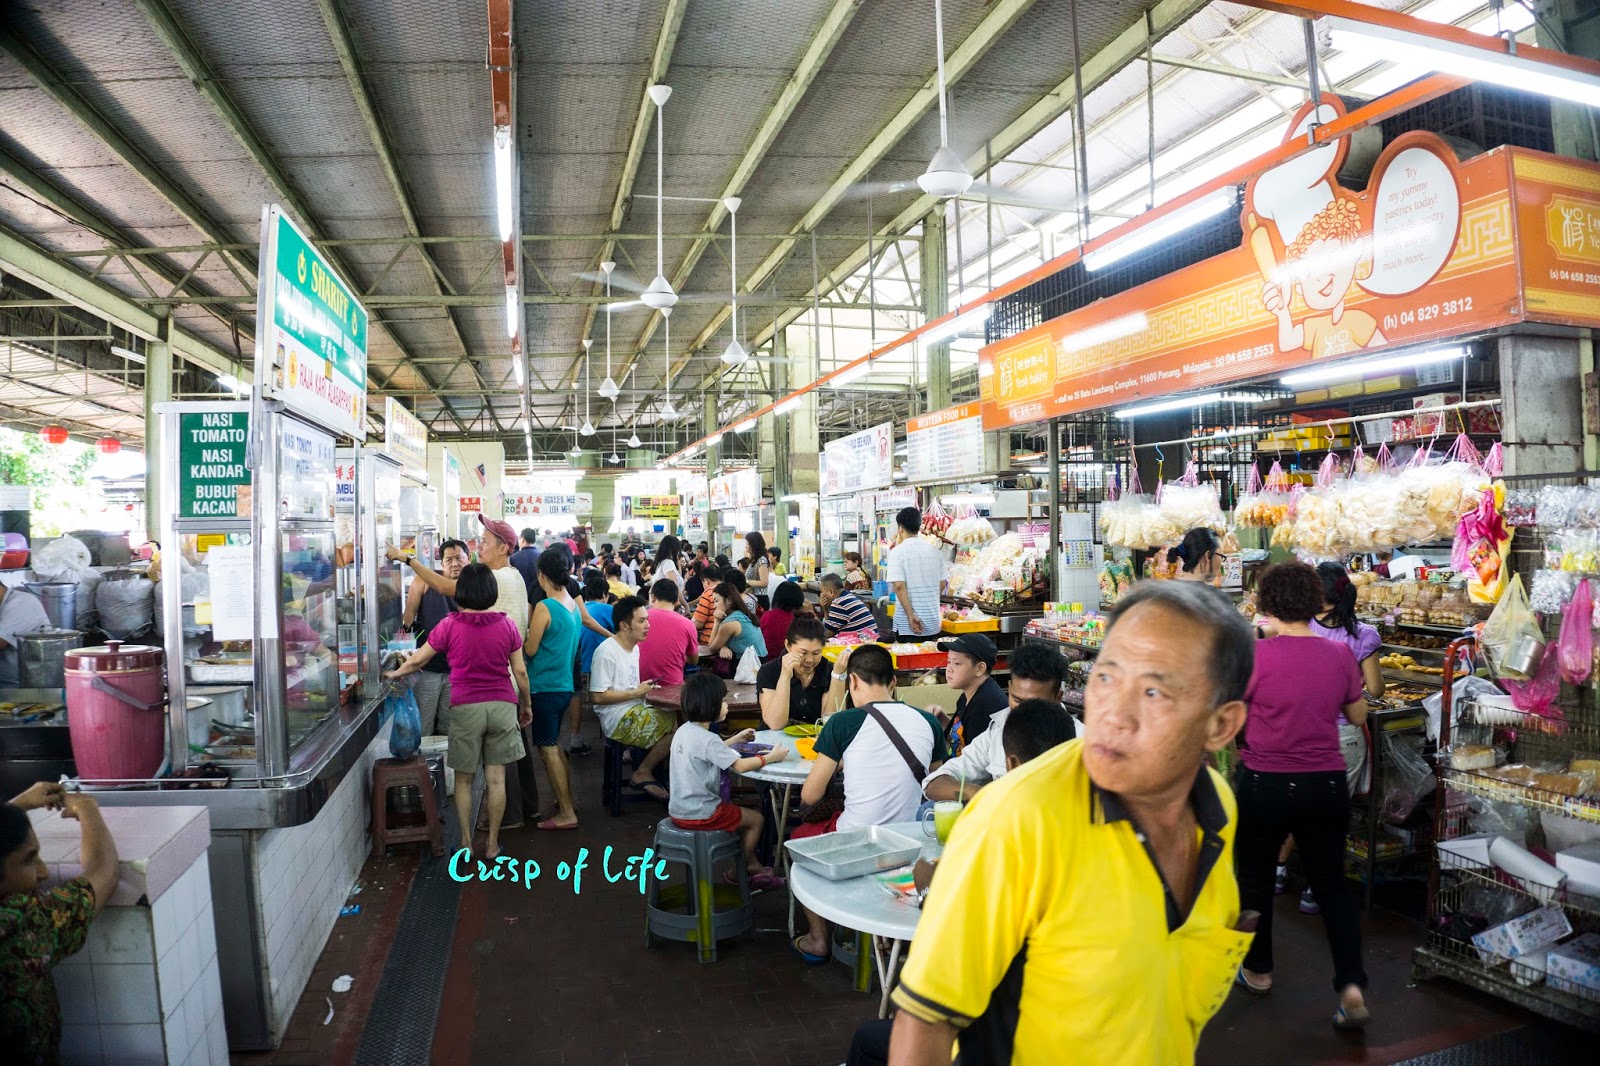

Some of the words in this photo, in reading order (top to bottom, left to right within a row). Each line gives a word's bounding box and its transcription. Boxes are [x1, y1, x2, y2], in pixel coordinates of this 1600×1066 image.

[1405, 167, 1417, 181] Try
[1388, 192, 1400, 205] my
[1401, 180, 1428, 200] yummy
[1384, 202, 1412, 225] pastries
[1414, 193, 1438, 214] today!
[1382, 256, 1403, 273] much
[1560, 269, 1569, 281] 04
[1571, 271, 1584, 283] 658
[311, 260, 349, 324] SHARIFF
[1383, 314, 1398, 331] (h)
[1400, 310, 1415, 326] 04
[1417, 304, 1439, 322] 829
[1442, 296, 1473, 317] 3812
[1140, 371, 1157, 384] 11600
[1157, 367, 1181, 380] Penang,
[1237, 348, 1252, 361] 658
[1253, 343, 1274, 358] 2553
[203, 413, 233, 427] NASI
[943, 409, 959, 422] FOOD
[190, 429, 245, 443] TOMATO
[202, 449, 233, 463] NASI
[190, 464, 244, 478] KANDAR
